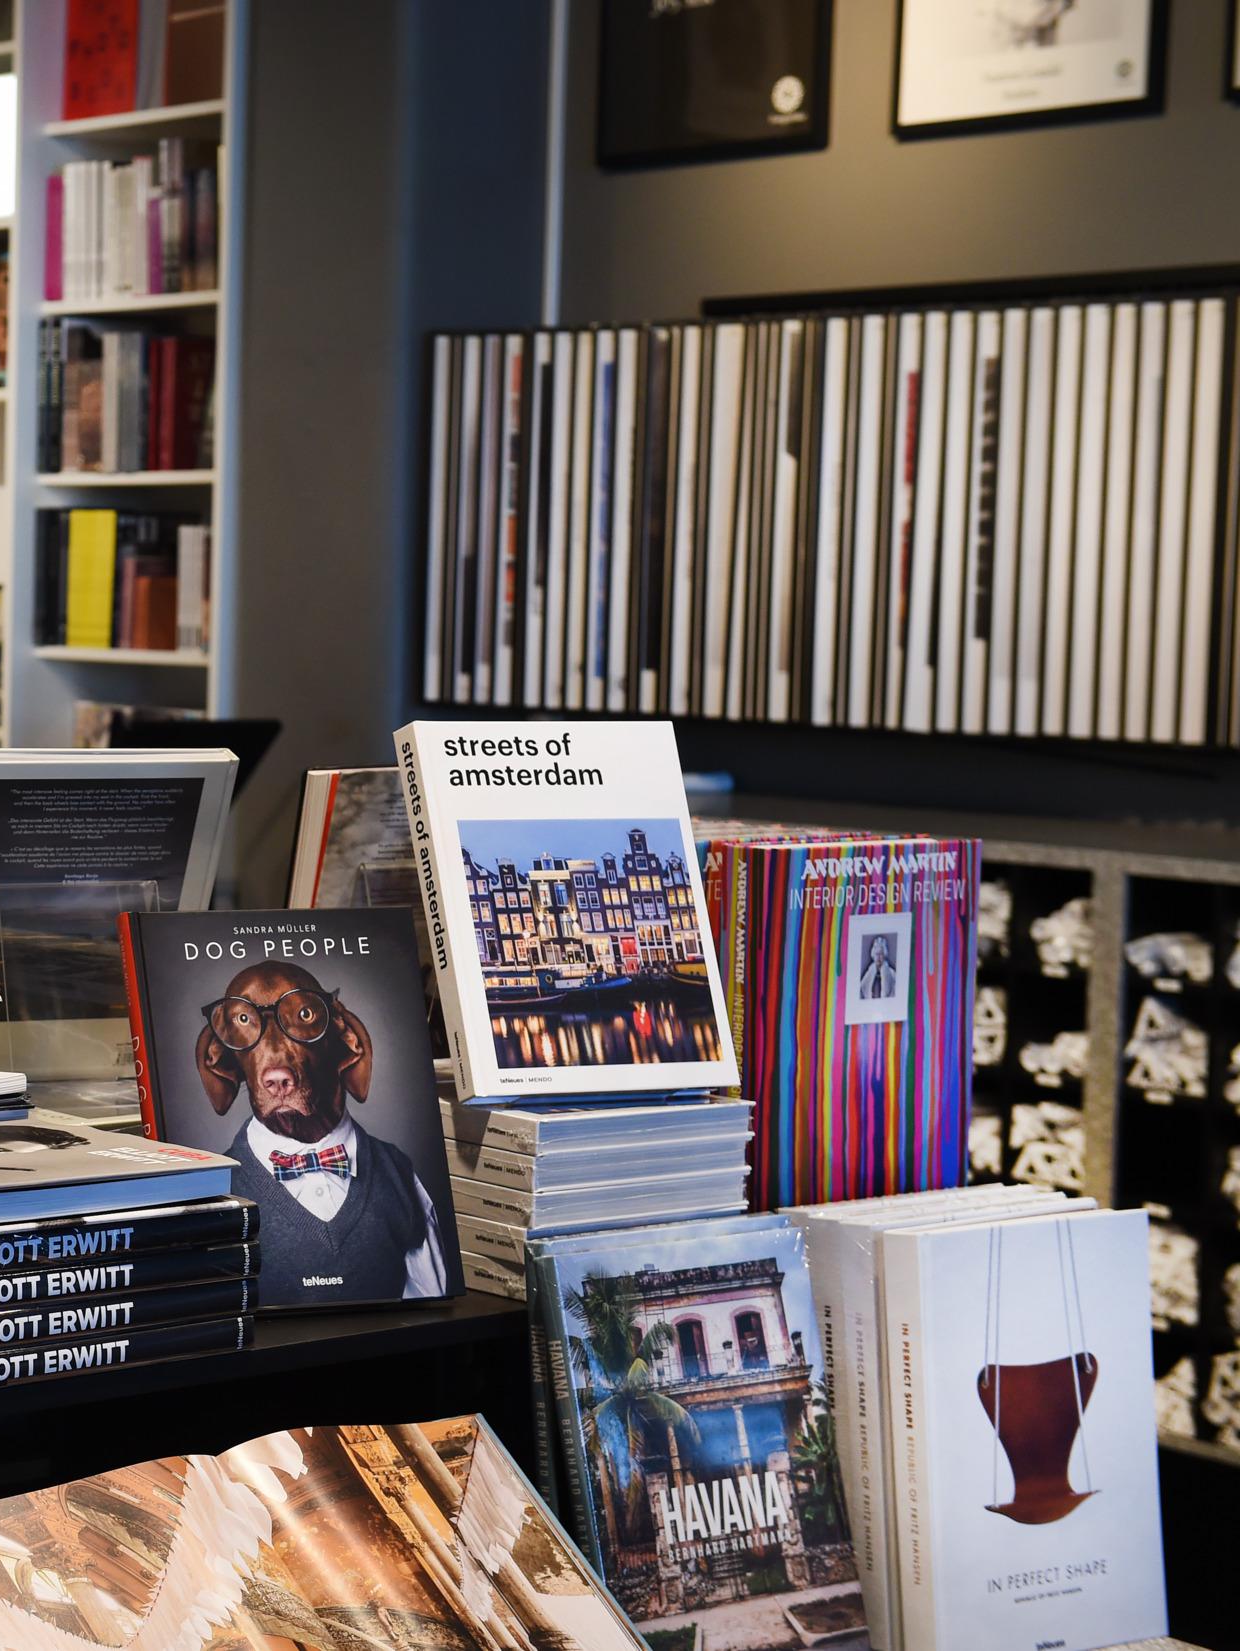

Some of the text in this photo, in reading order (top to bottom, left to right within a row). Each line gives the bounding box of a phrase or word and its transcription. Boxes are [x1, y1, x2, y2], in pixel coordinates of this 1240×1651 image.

[444, 732, 571, 756] streets of
[449, 762, 603, 786] amsterdam
[401, 741, 448, 970] streets of amsterdam
[801, 851, 958, 880] ANDREW MARTIN
[737, 859, 748, 928] ANDREW
[789, 879, 967, 910] INTERIOR DESIGN REVIEW
[233, 924, 317, 935] SANDRA MÜLLER
[184, 937, 370, 960] DOG PEOPLE
[734, 994, 744, 1054] INTERIOR
[48, 1227, 134, 1259] ERWITT
[47, 1264, 134, 1296] ERWITT
[302, 1275, 344, 1287] teNeues
[48, 1302, 134, 1335] ERWITT
[824, 1305, 830, 1318] IN
[902, 1323, 909, 1336] IN
[44, 1340, 129, 1373] ERWITT
[825, 1322, 834, 1370] PERFECT
[856, 1329, 865, 1377] PERFECT
[903, 1341, 912, 1388] PERFECT
[858, 1380, 866, 1418] SHAPE
[905, 1392, 913, 1430] SHAPE
[548, 1340, 569, 1400] HAVANA
[562, 1418, 581, 1495] BERNHARD
[860, 1423, 869, 1471] REPUBLIC
[863, 1477, 870, 1492] OF
[909, 1487, 917, 1502] OF
[660, 1471, 790, 1544] HAVANA
[863, 1495, 871, 1523] FRITZ
[910, 1506, 919, 1535] FRITZ
[668, 1540, 727, 1563] BERNHARD
[865, 1526, 873, 1572] HANSEN
[912, 1539, 921, 1586] HANSEN
[987, 1558, 1107, 1593] IN PERFECT SHAPE
